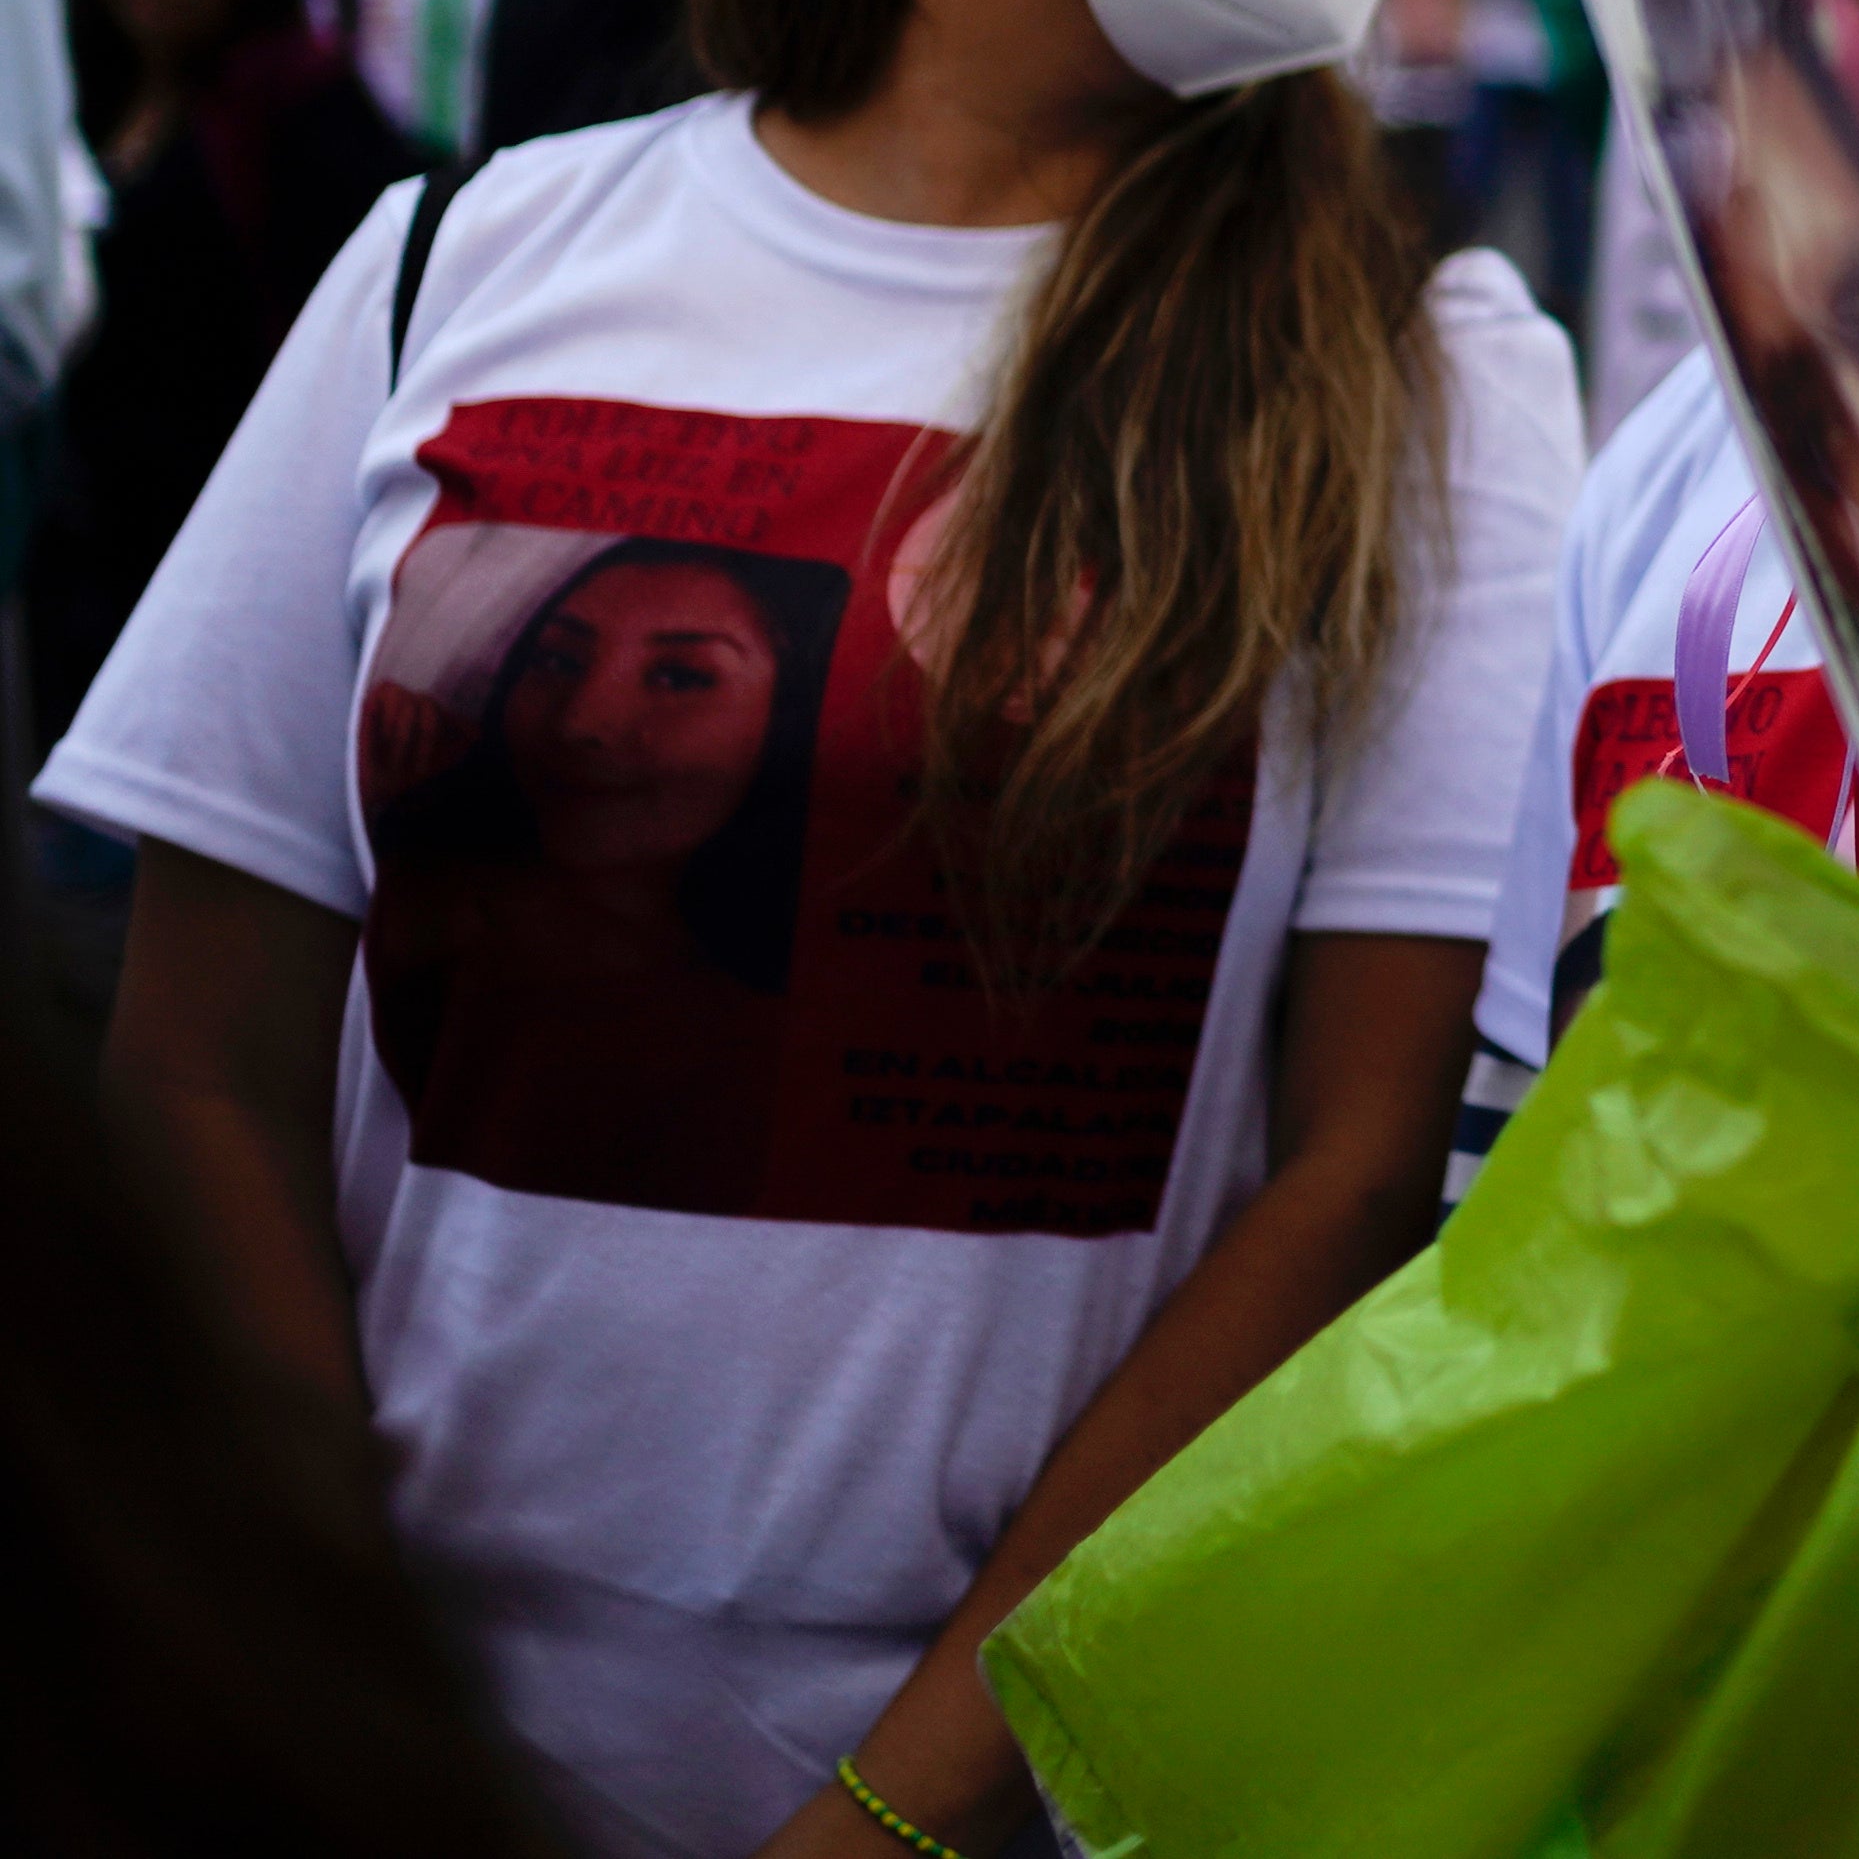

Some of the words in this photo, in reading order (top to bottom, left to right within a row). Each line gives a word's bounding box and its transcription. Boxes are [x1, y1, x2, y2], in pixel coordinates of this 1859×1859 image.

[520, 478, 774, 542] CAMINO
[842, 1048, 921, 1080] EN
[907, 1146, 1112, 1187] CIUDAD
